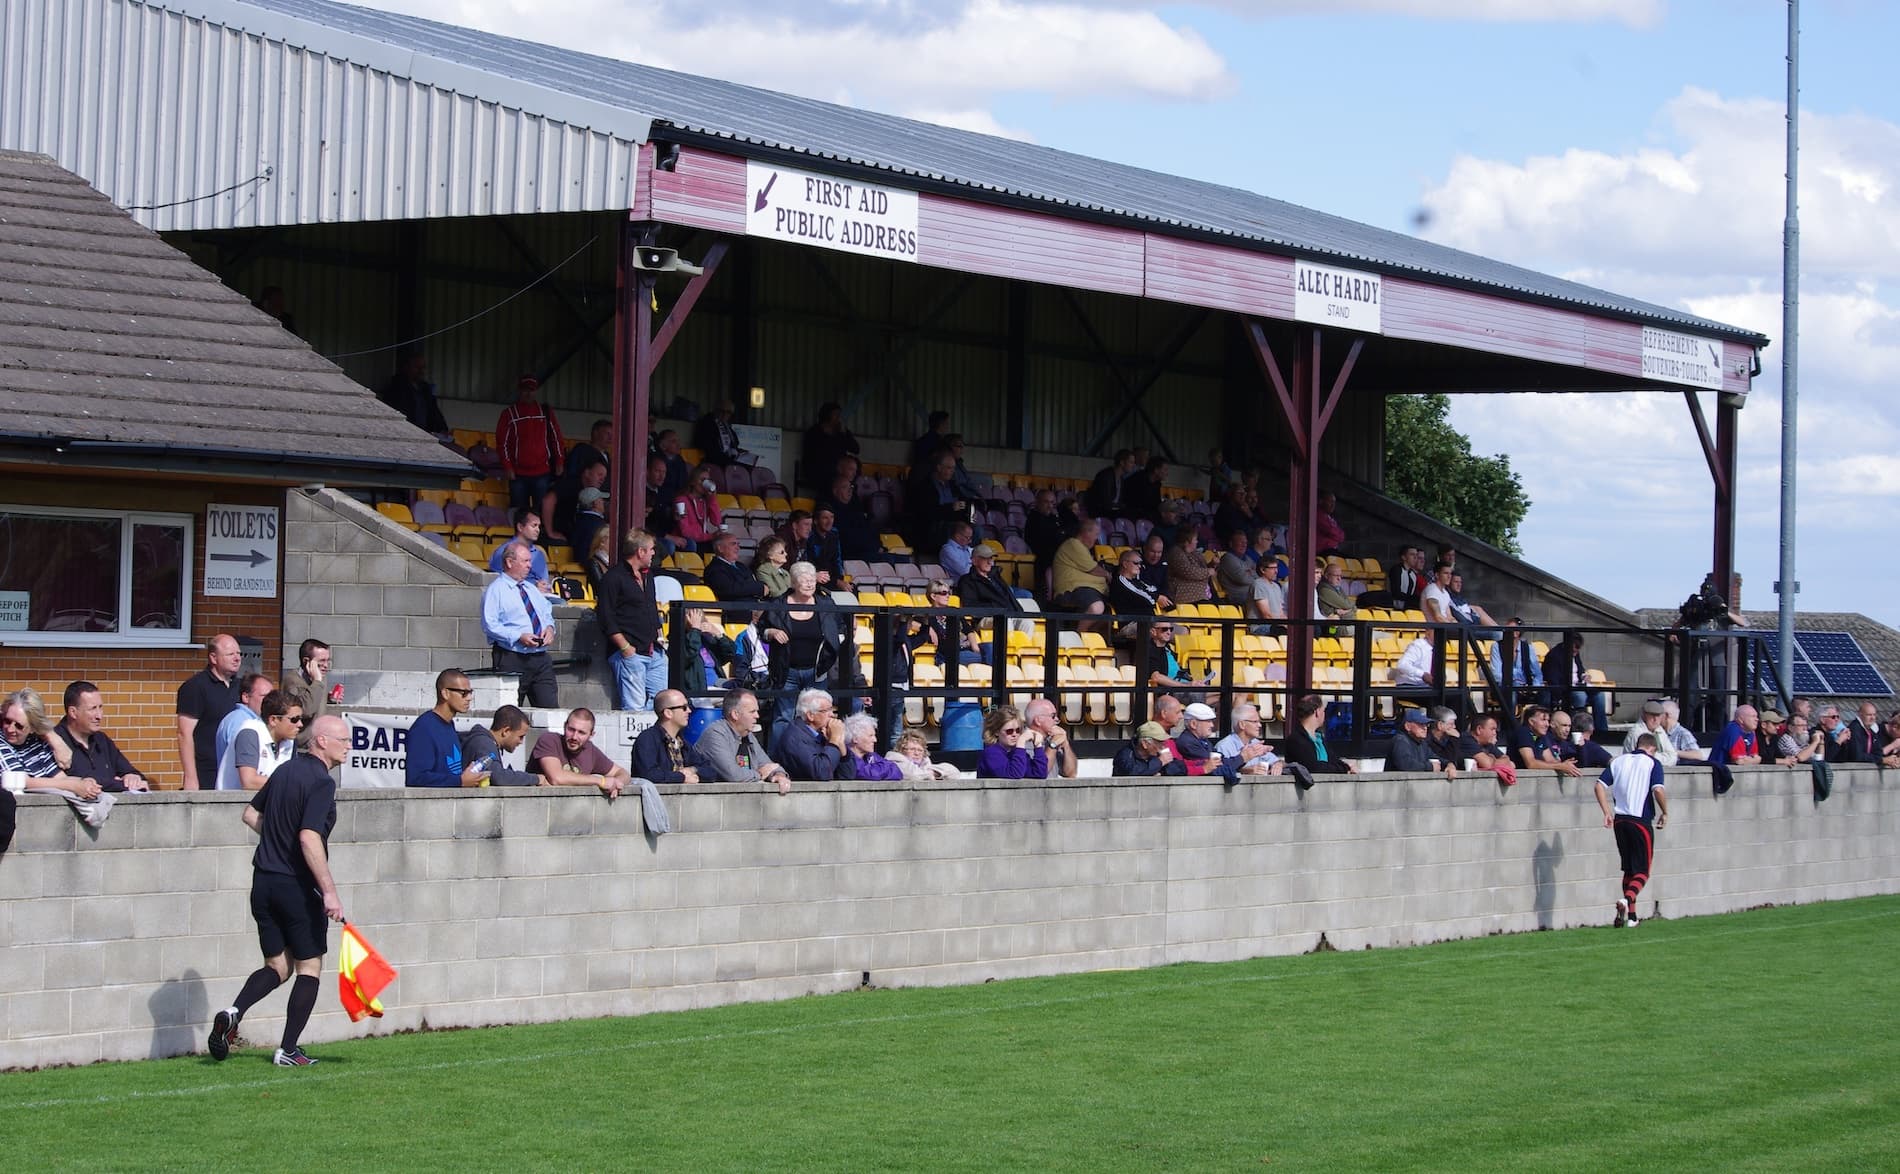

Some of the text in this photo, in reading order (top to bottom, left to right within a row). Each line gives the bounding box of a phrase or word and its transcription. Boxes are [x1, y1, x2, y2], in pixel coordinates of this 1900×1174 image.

[805, 177, 888, 215] FIRST AID
[775, 207, 917, 255] PUBLIC ADDRESS
[1297, 267, 1379, 304] ALEC HARDY
[1327, 303, 1350, 319] STAND
[209, 510, 276, 540] TOILETS
[207, 577, 275, 591] BEHIND GRANDSTAND
[13, 600, 29, 610] OFF
[626, 717, 651, 732] Bar
[352, 726, 408, 752] BAR
